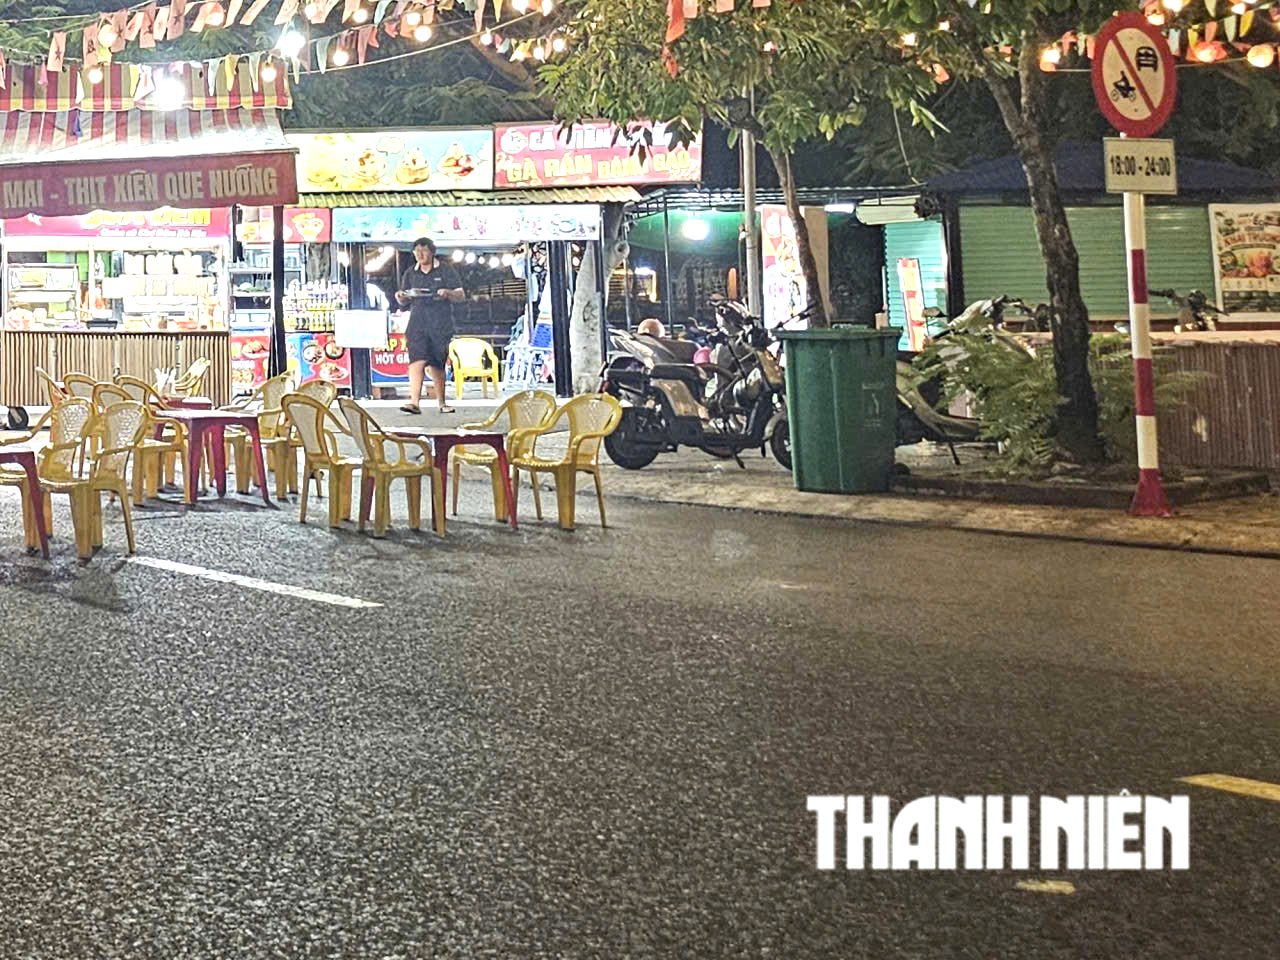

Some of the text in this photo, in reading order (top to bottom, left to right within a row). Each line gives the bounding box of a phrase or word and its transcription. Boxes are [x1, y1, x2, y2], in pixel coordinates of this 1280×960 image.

[507, 157, 538, 182] GÀ
[543, 152, 593, 178] RÁN
[1110, 155, 1136, 176] 18:00
[1144, 155, 1171, 177] 24:00
[3, 179, 44, 209] MAI
[64, 176, 107, 209] THỊT
[114, 169, 160, 204] XIÊN
[164, 171, 204, 202] QUE
[209, 163, 278, 198] NƯỚNG
